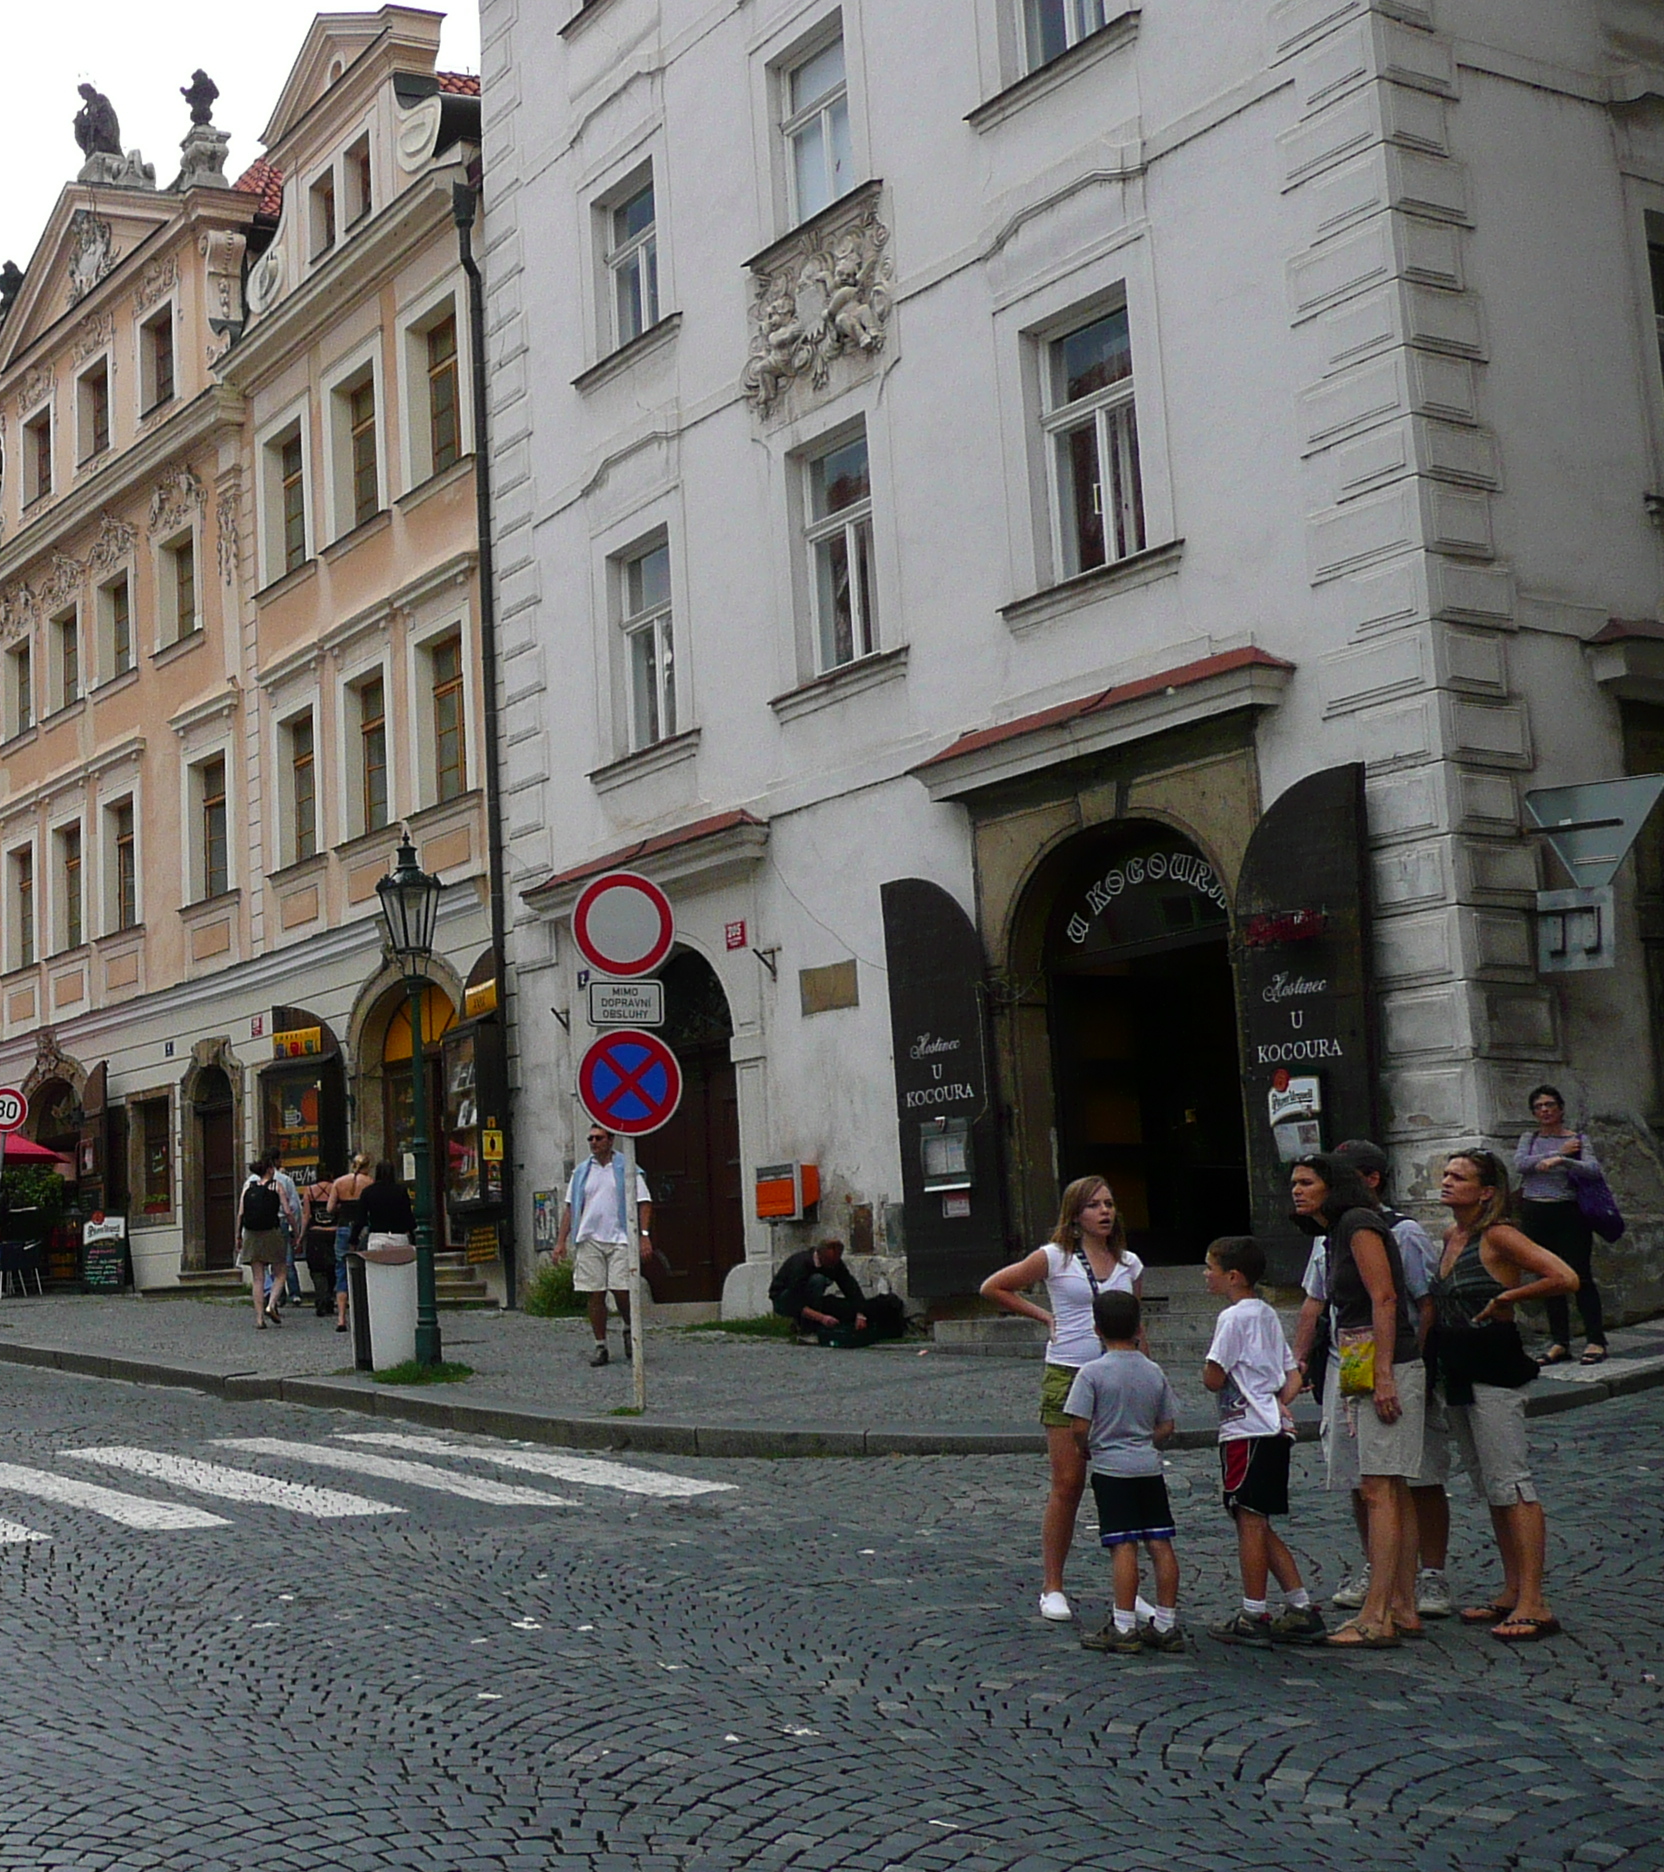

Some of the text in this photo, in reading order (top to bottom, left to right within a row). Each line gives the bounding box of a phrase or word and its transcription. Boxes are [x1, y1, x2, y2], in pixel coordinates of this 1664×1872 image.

[1066, 912, 1089, 943] U
[612, 987, 638, 996] MIMO
[1263, 971, 1327, 1002] Hostinec
[601, 997, 652, 1008] DOPRAVNÍ
[602, 1009, 649, 1019] OBSLUHY
[1291, 1011, 1303, 1029] U
[910, 1033, 961, 1059] Hostinec
[1257, 1039, 1343, 1064] KOCOURA
[932, 1064, 943, 1080] U
[907, 1083, 975, 1108] KOCOURA
